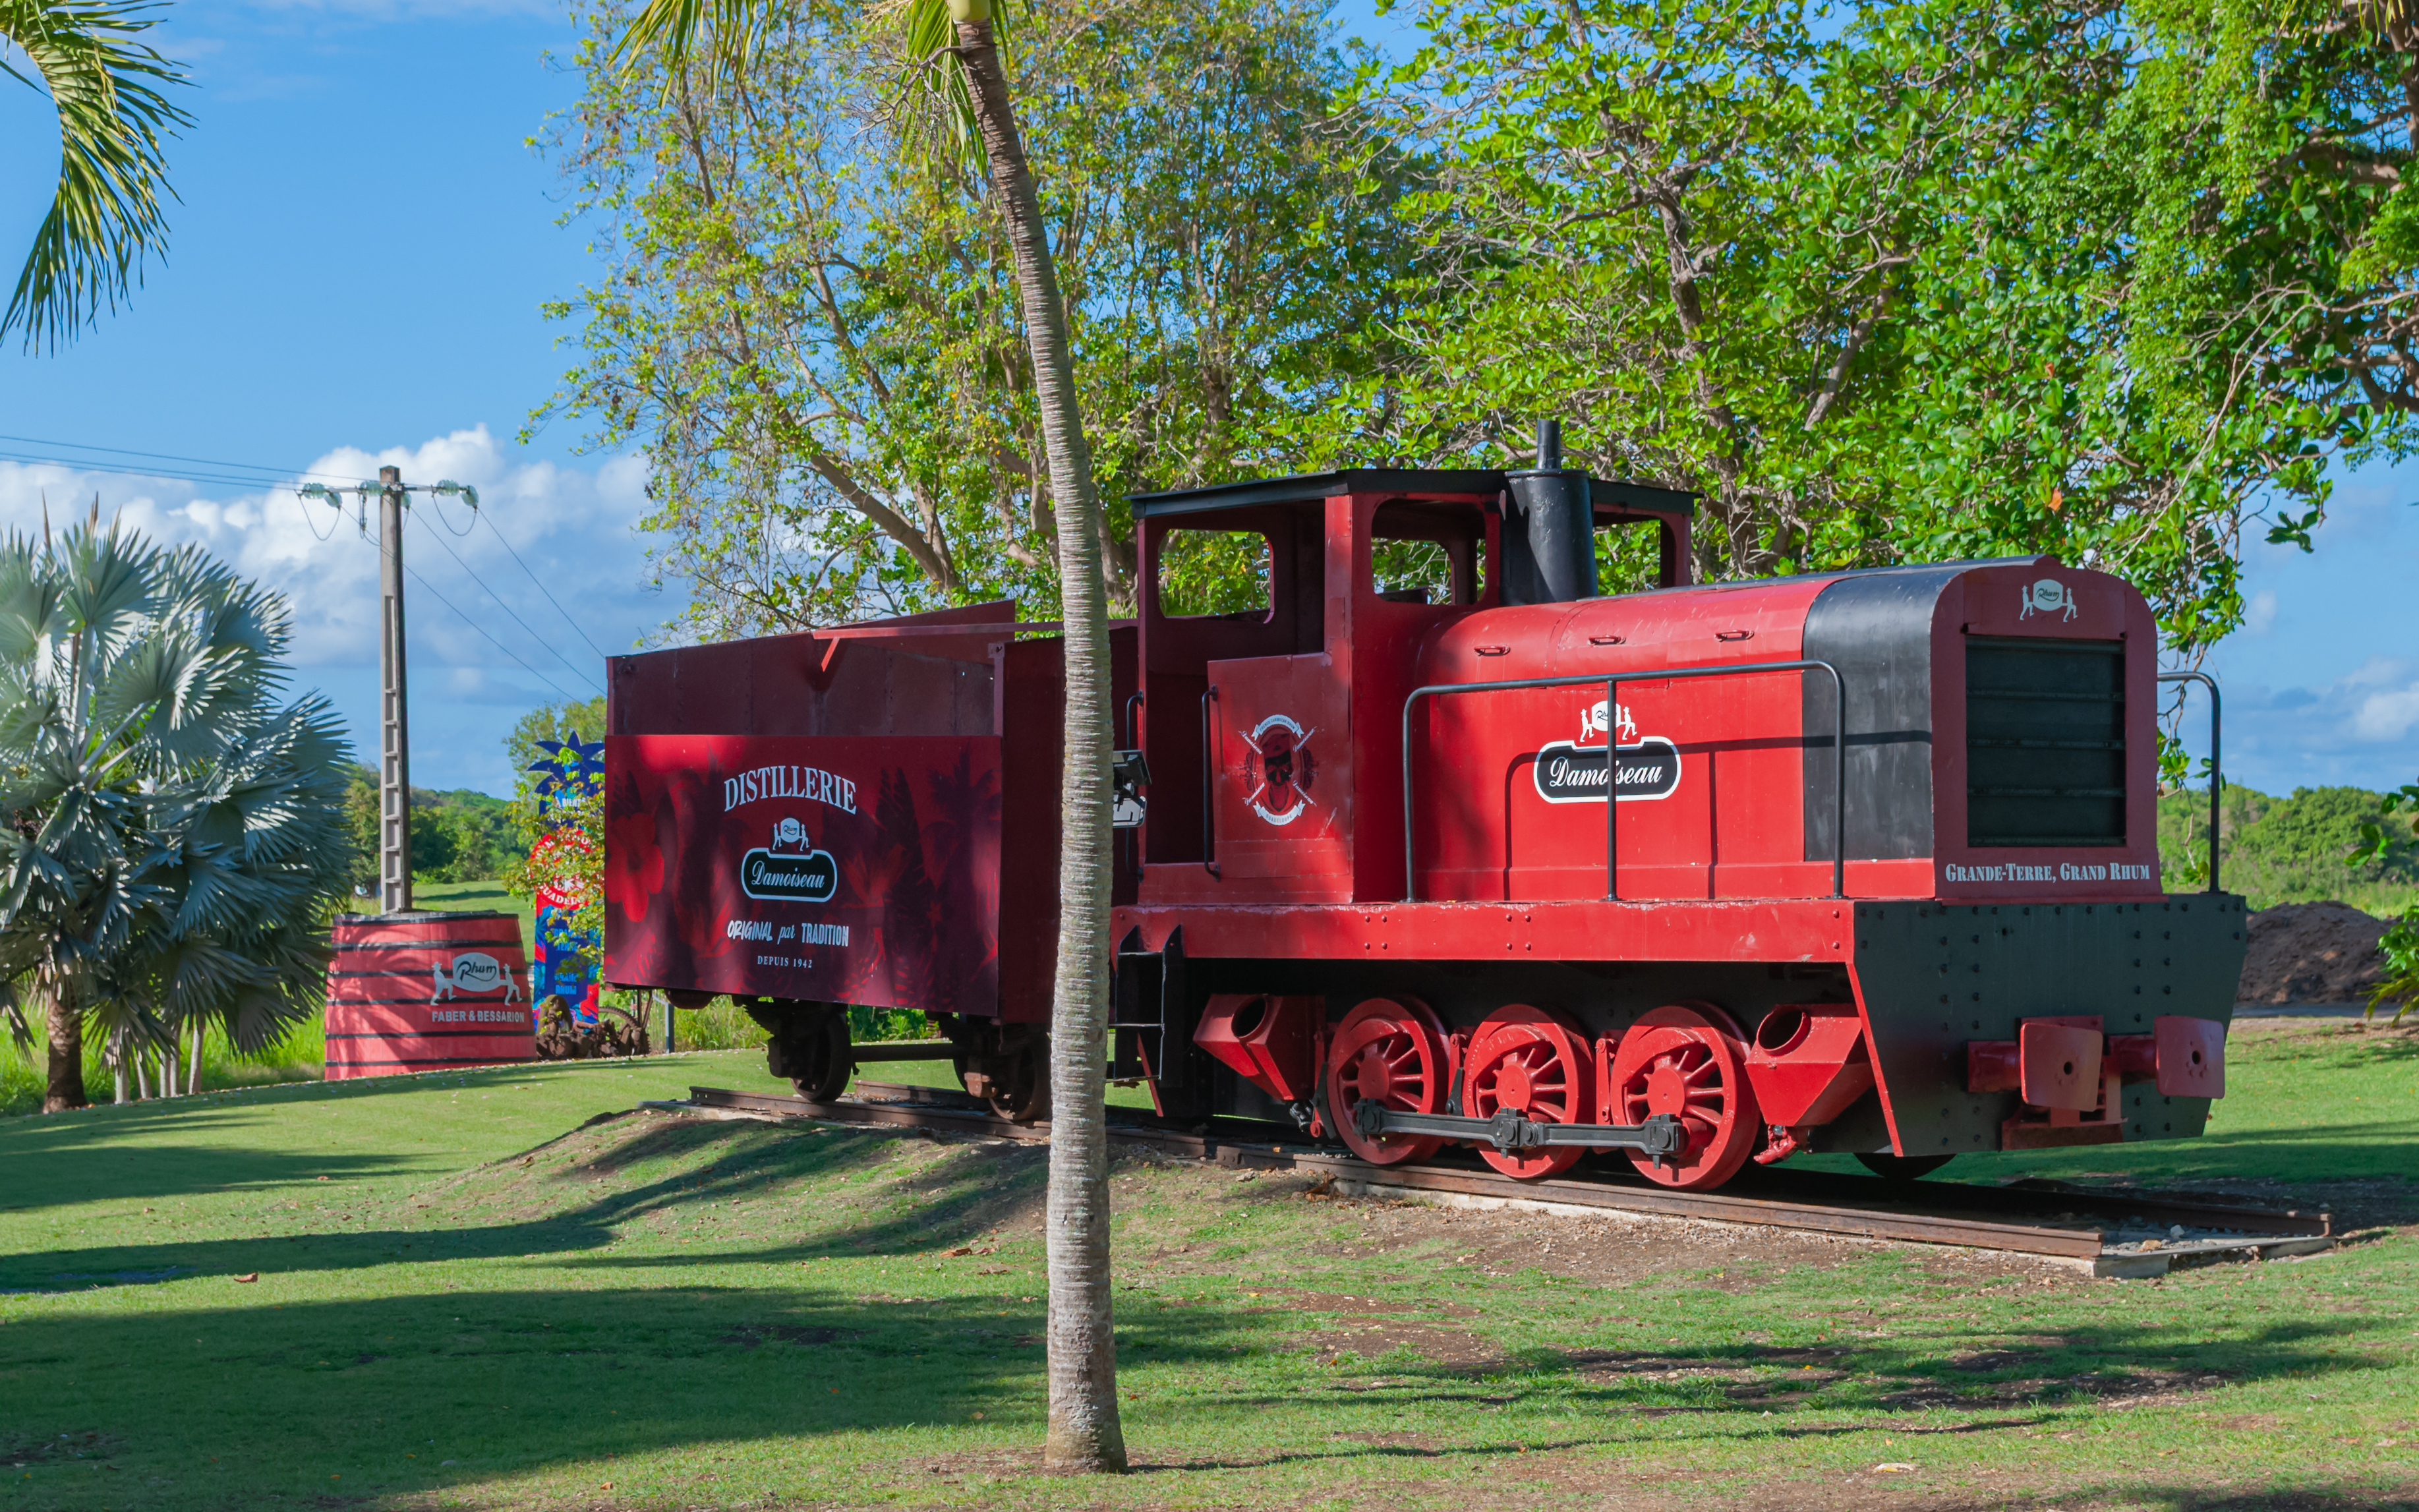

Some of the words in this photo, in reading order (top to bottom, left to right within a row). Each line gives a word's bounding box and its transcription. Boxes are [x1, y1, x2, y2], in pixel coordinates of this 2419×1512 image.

[2036, 588, 2060, 602] Rhum
[1549, 756, 1662, 787] Damoseau
[724, 765, 857, 815] DISTILLERIE
[751, 860, 825, 889] Damoiseau
[1945, 863, 2057, 883] GRANDE-TERRE,
[2060, 862, 2107, 881] GRAND
[2109, 862, 2150, 881] RHUM
[727, 920, 772, 941] ORIGINAL
[777, 924, 796, 945] par
[801, 923, 849, 946] TRADITION
[456, 960, 497, 983] Rhum
[757, 956, 789, 967] DEPUIS
[793, 958, 813, 968] 1942
[432, 1010, 466, 1022] FABER
[469, 1010, 476, 1022] &
[477, 1010, 525, 1023] BESSARION
